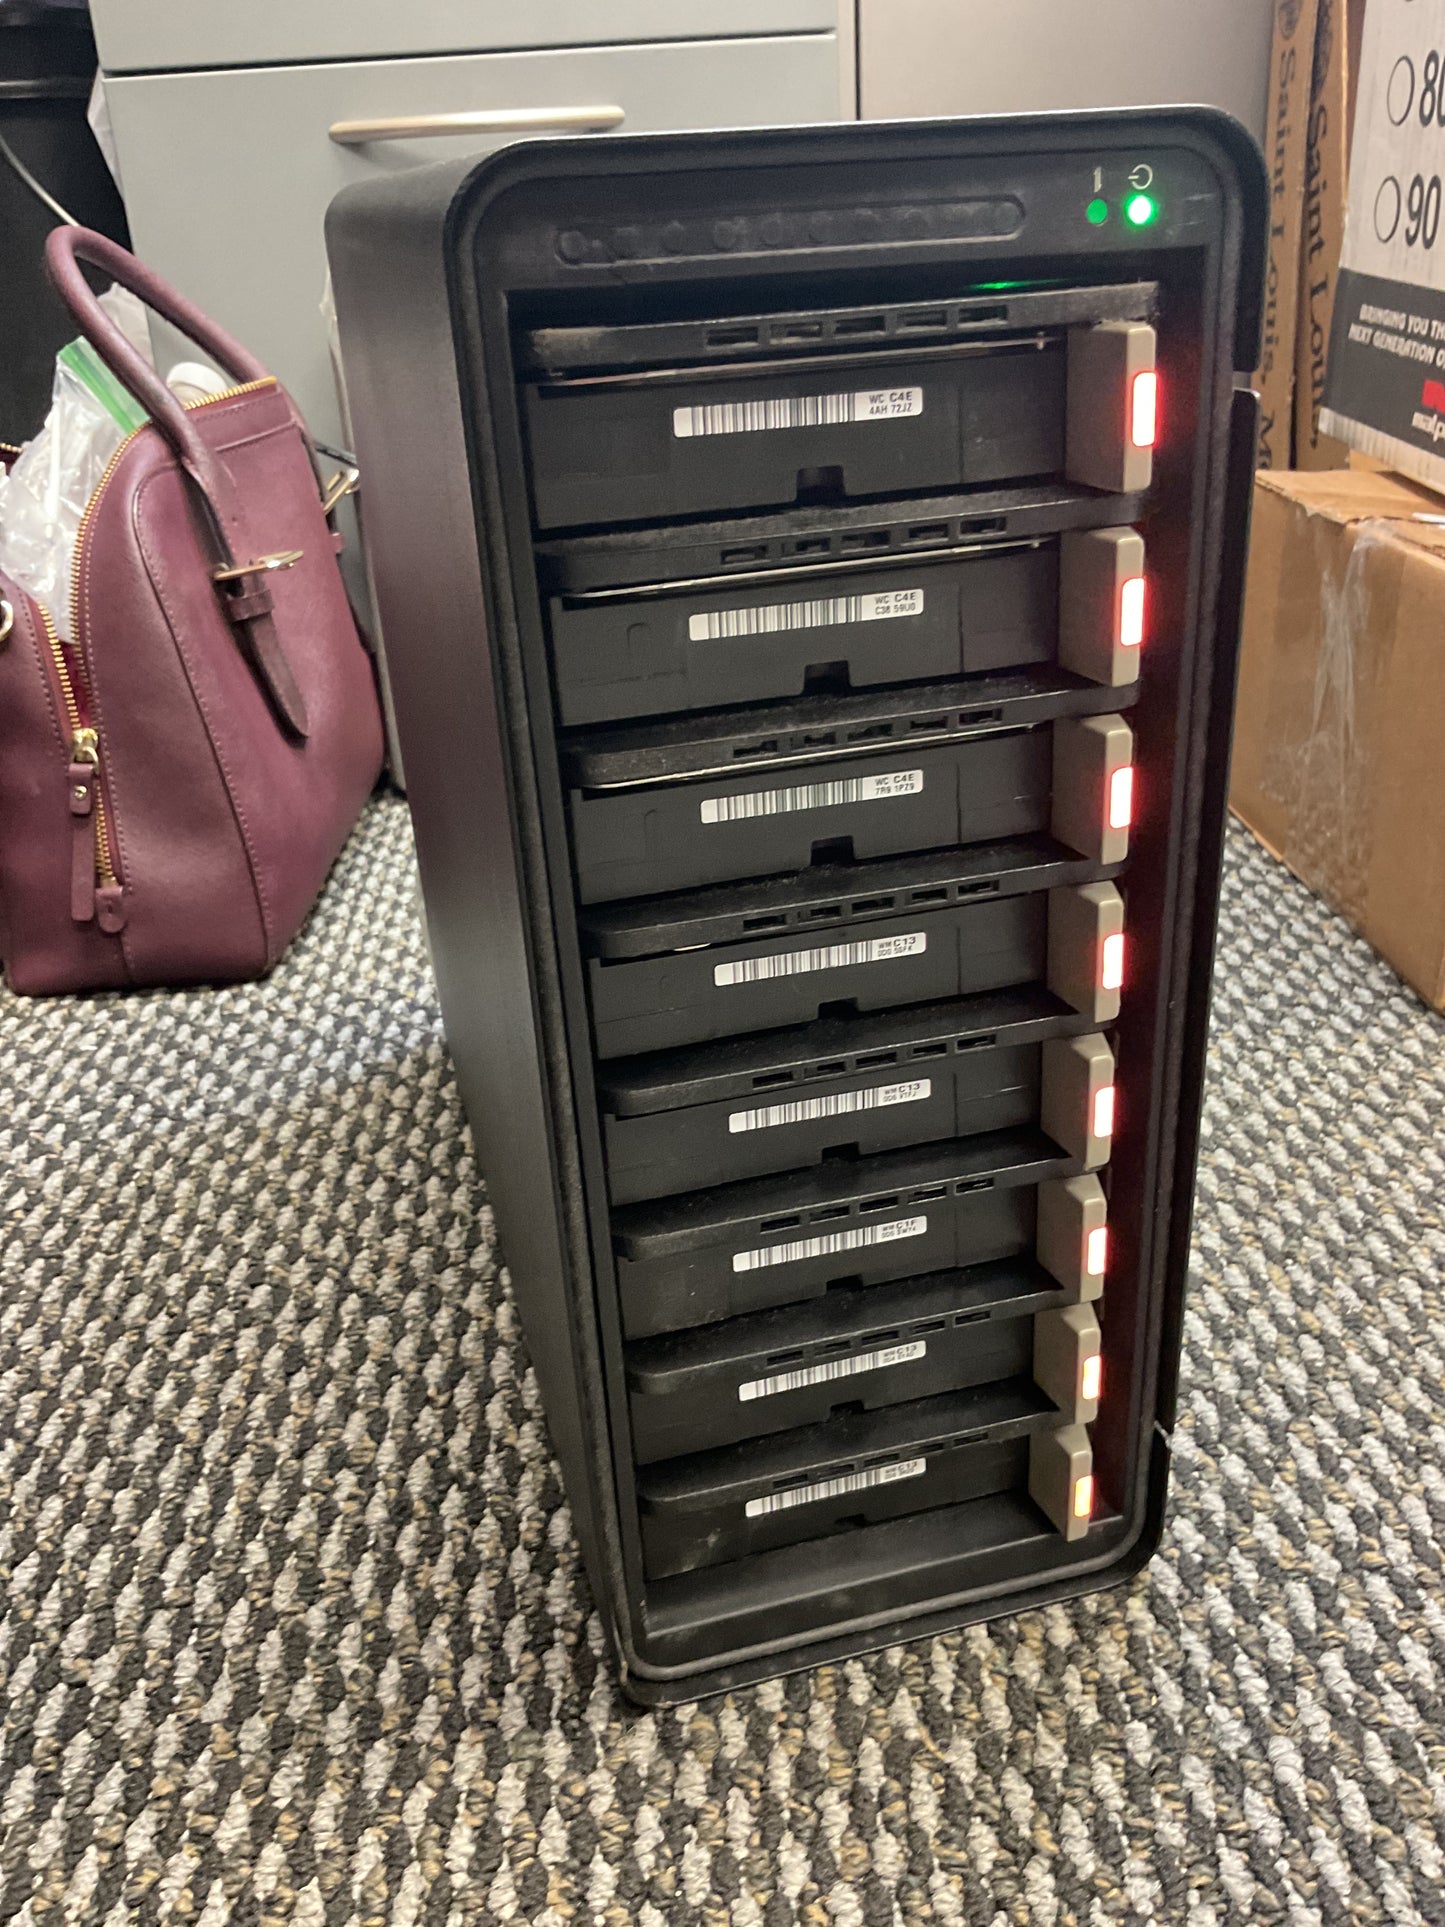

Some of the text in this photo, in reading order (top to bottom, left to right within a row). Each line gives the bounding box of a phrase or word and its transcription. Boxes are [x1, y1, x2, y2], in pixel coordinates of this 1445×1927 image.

[1272, 46, 1296, 198] Saint
[1307, 104, 1328, 264] Saint
[1405, 173, 1441, 250] 90
[1359, 303, 1407, 331] BRINGING
[1408, 314, 1430, 336] YOU
[1348, 322, 1373, 345] NEXT
[1372, 330, 1436, 365] GENERATION
[869, 391, 912, 404] WC C4E
[870, 405, 888, 415] 4AH
[874, 592, 916, 604] WC C4E
[875, 773, 915, 786] WC C4E
[893, 936, 916, 947] C13
[898, 1083, 920, 1093] C13
